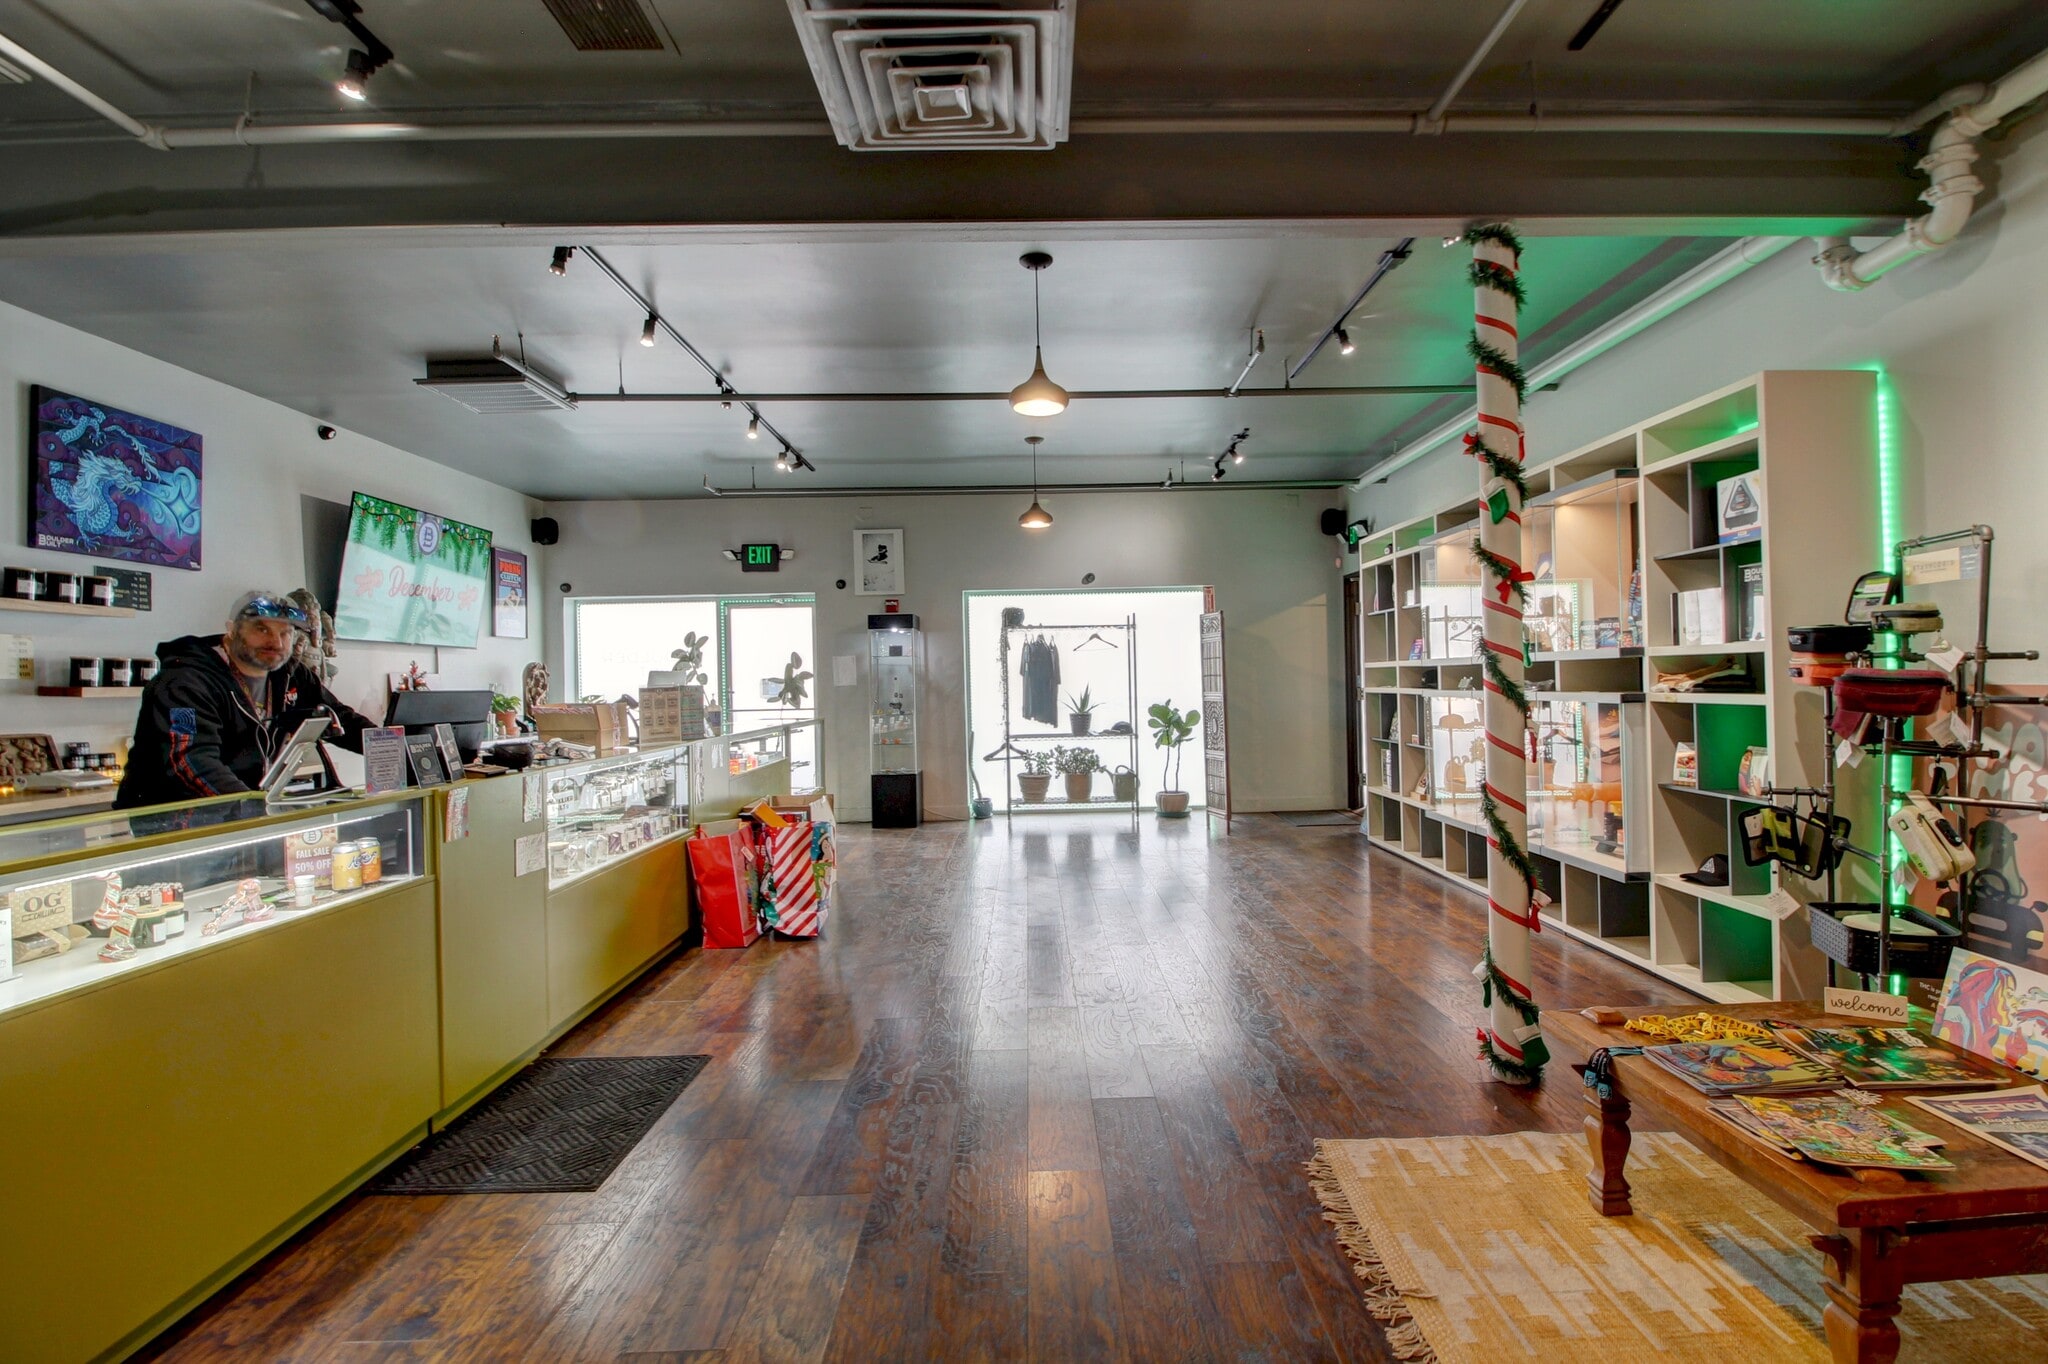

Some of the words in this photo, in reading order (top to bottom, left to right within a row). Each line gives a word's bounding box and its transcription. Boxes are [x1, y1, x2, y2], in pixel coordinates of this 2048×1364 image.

[748, 546, 772, 564] EXIT
[389, 565, 453, 601] December
[296, 850, 312, 859] FALL
[313, 846, 330, 857] SALE
[295, 860, 314, 873] 50%
[316, 859, 332, 869] OFF
[24, 892, 62, 912] OG
[1831, 995, 1904, 1017] welcome
[1935, 1101, 2048, 1113] WEEKLY
